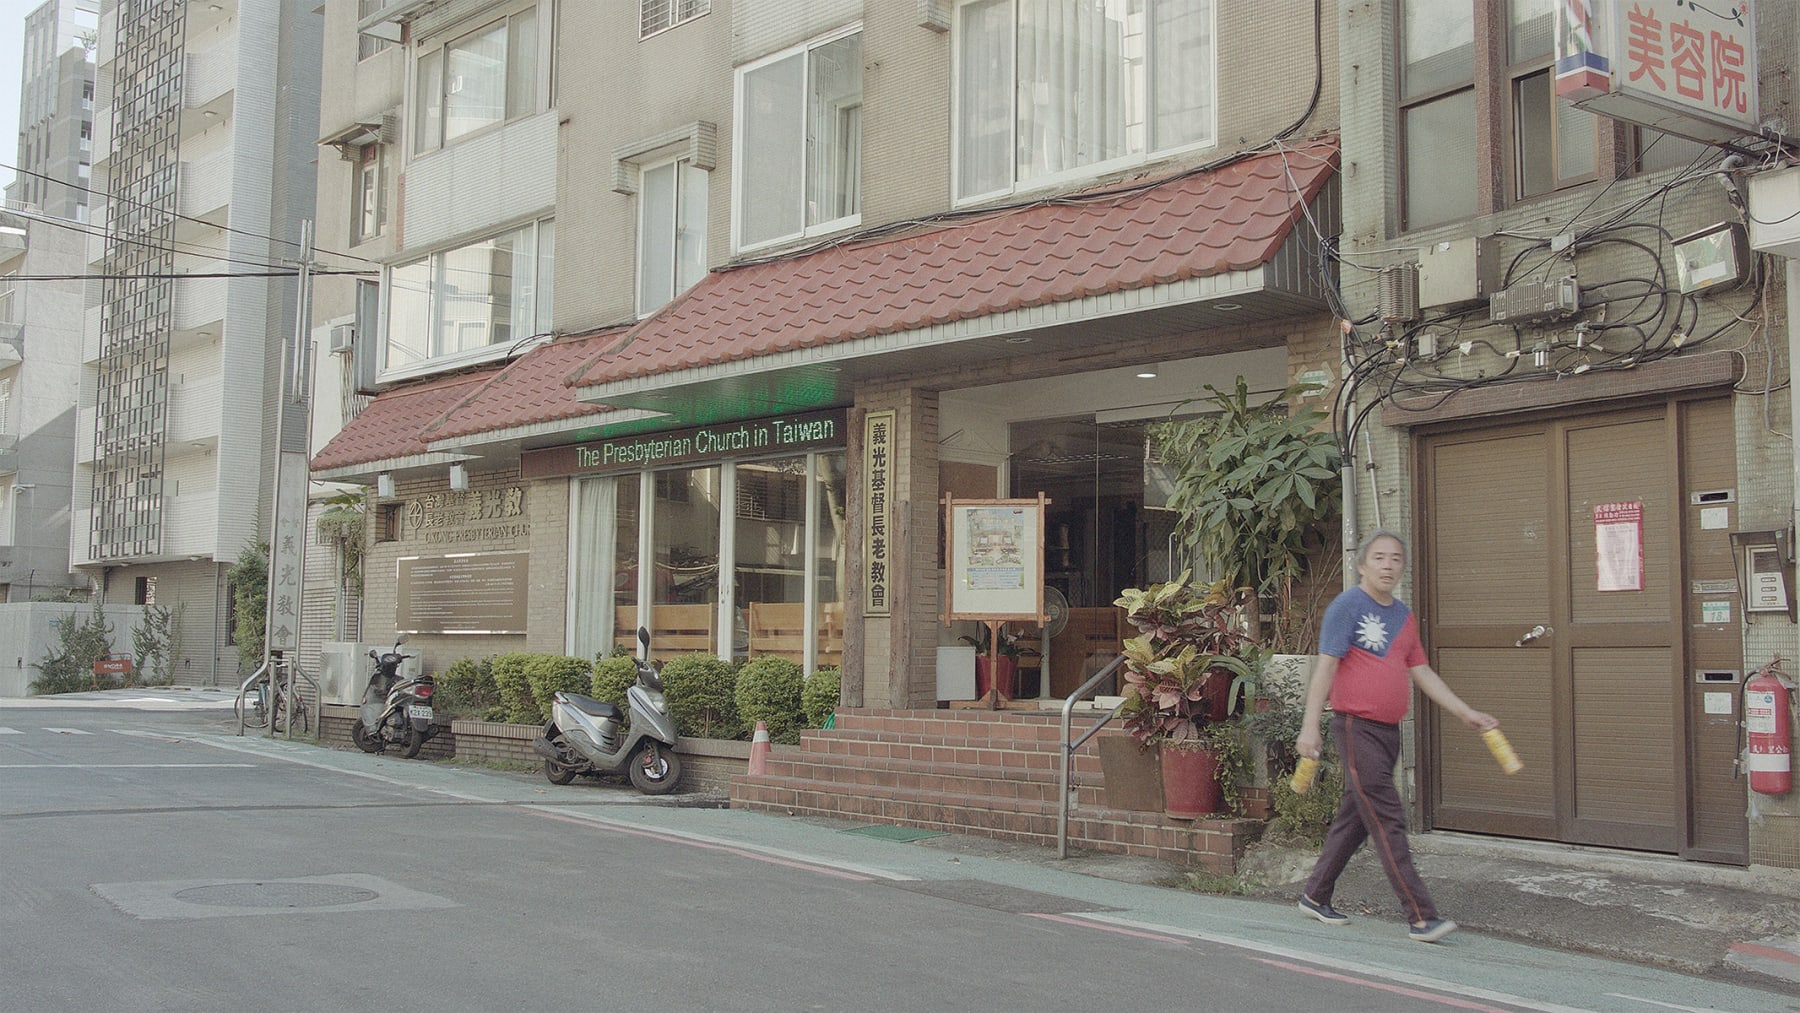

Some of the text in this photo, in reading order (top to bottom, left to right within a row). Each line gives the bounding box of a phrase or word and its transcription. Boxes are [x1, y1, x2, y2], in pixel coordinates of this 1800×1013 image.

[1627, 2, 1747, 113] 美容院
[577, 419, 834, 467] The Presbyterian Church in Taiwan
[871, 423, 887, 607] 義光基督長老教會
